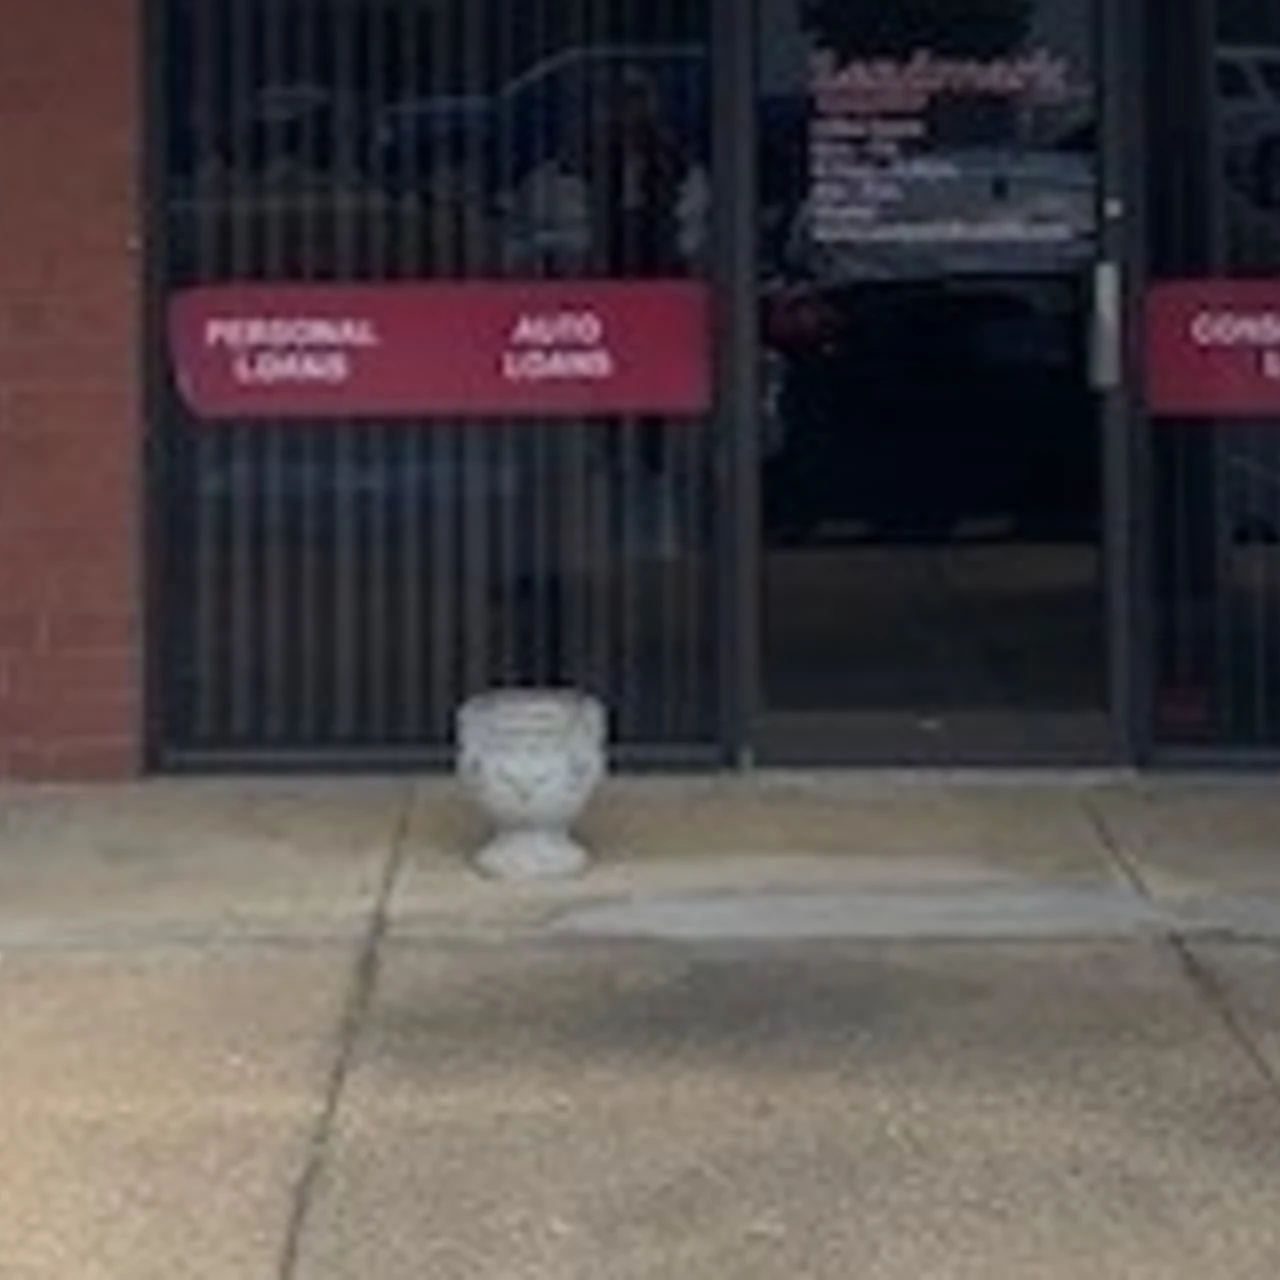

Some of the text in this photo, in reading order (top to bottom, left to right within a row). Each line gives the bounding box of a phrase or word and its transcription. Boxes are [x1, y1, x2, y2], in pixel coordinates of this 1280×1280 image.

[206, 318, 380, 348] PERSONAL
[509, 313, 604, 347] AUTO
[231, 350, 349, 386] LOANS
[500, 349, 615, 381] LOANS
